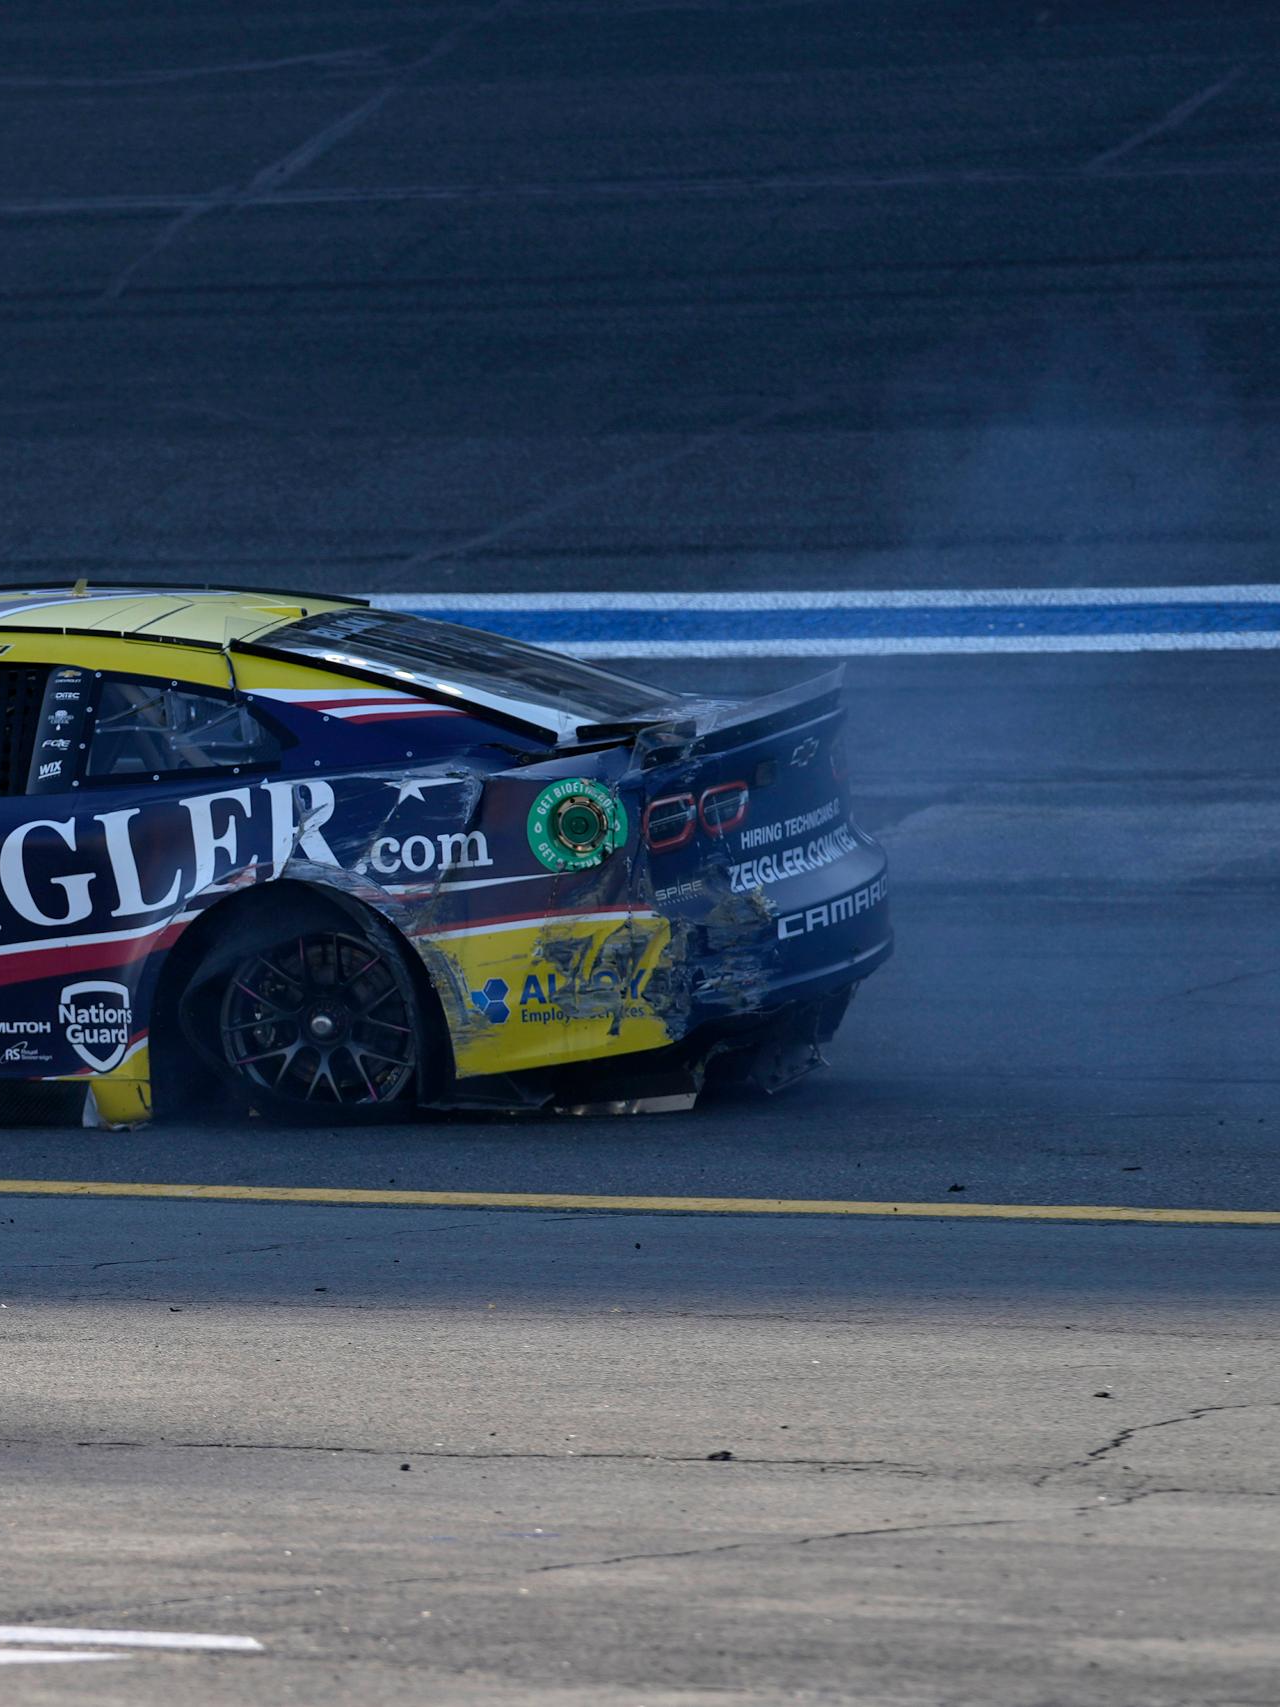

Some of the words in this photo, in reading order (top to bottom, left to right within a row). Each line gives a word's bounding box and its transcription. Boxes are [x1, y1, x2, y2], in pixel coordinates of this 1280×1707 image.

[39, 760, 63, 776] WIX
[537, 794, 554, 815] GET
[740, 820, 782, 850] HIRING
[538, 842, 556, 862] GET
[655, 879, 704, 902] SPIRE
[777, 873, 888, 940] CAMARO
[520, 968, 646, 1005] ALOY
[58, 1002, 132, 1024] Nations
[66, 1024, 128, 1044] Guard
[5, 1048, 21, 1060] RS
